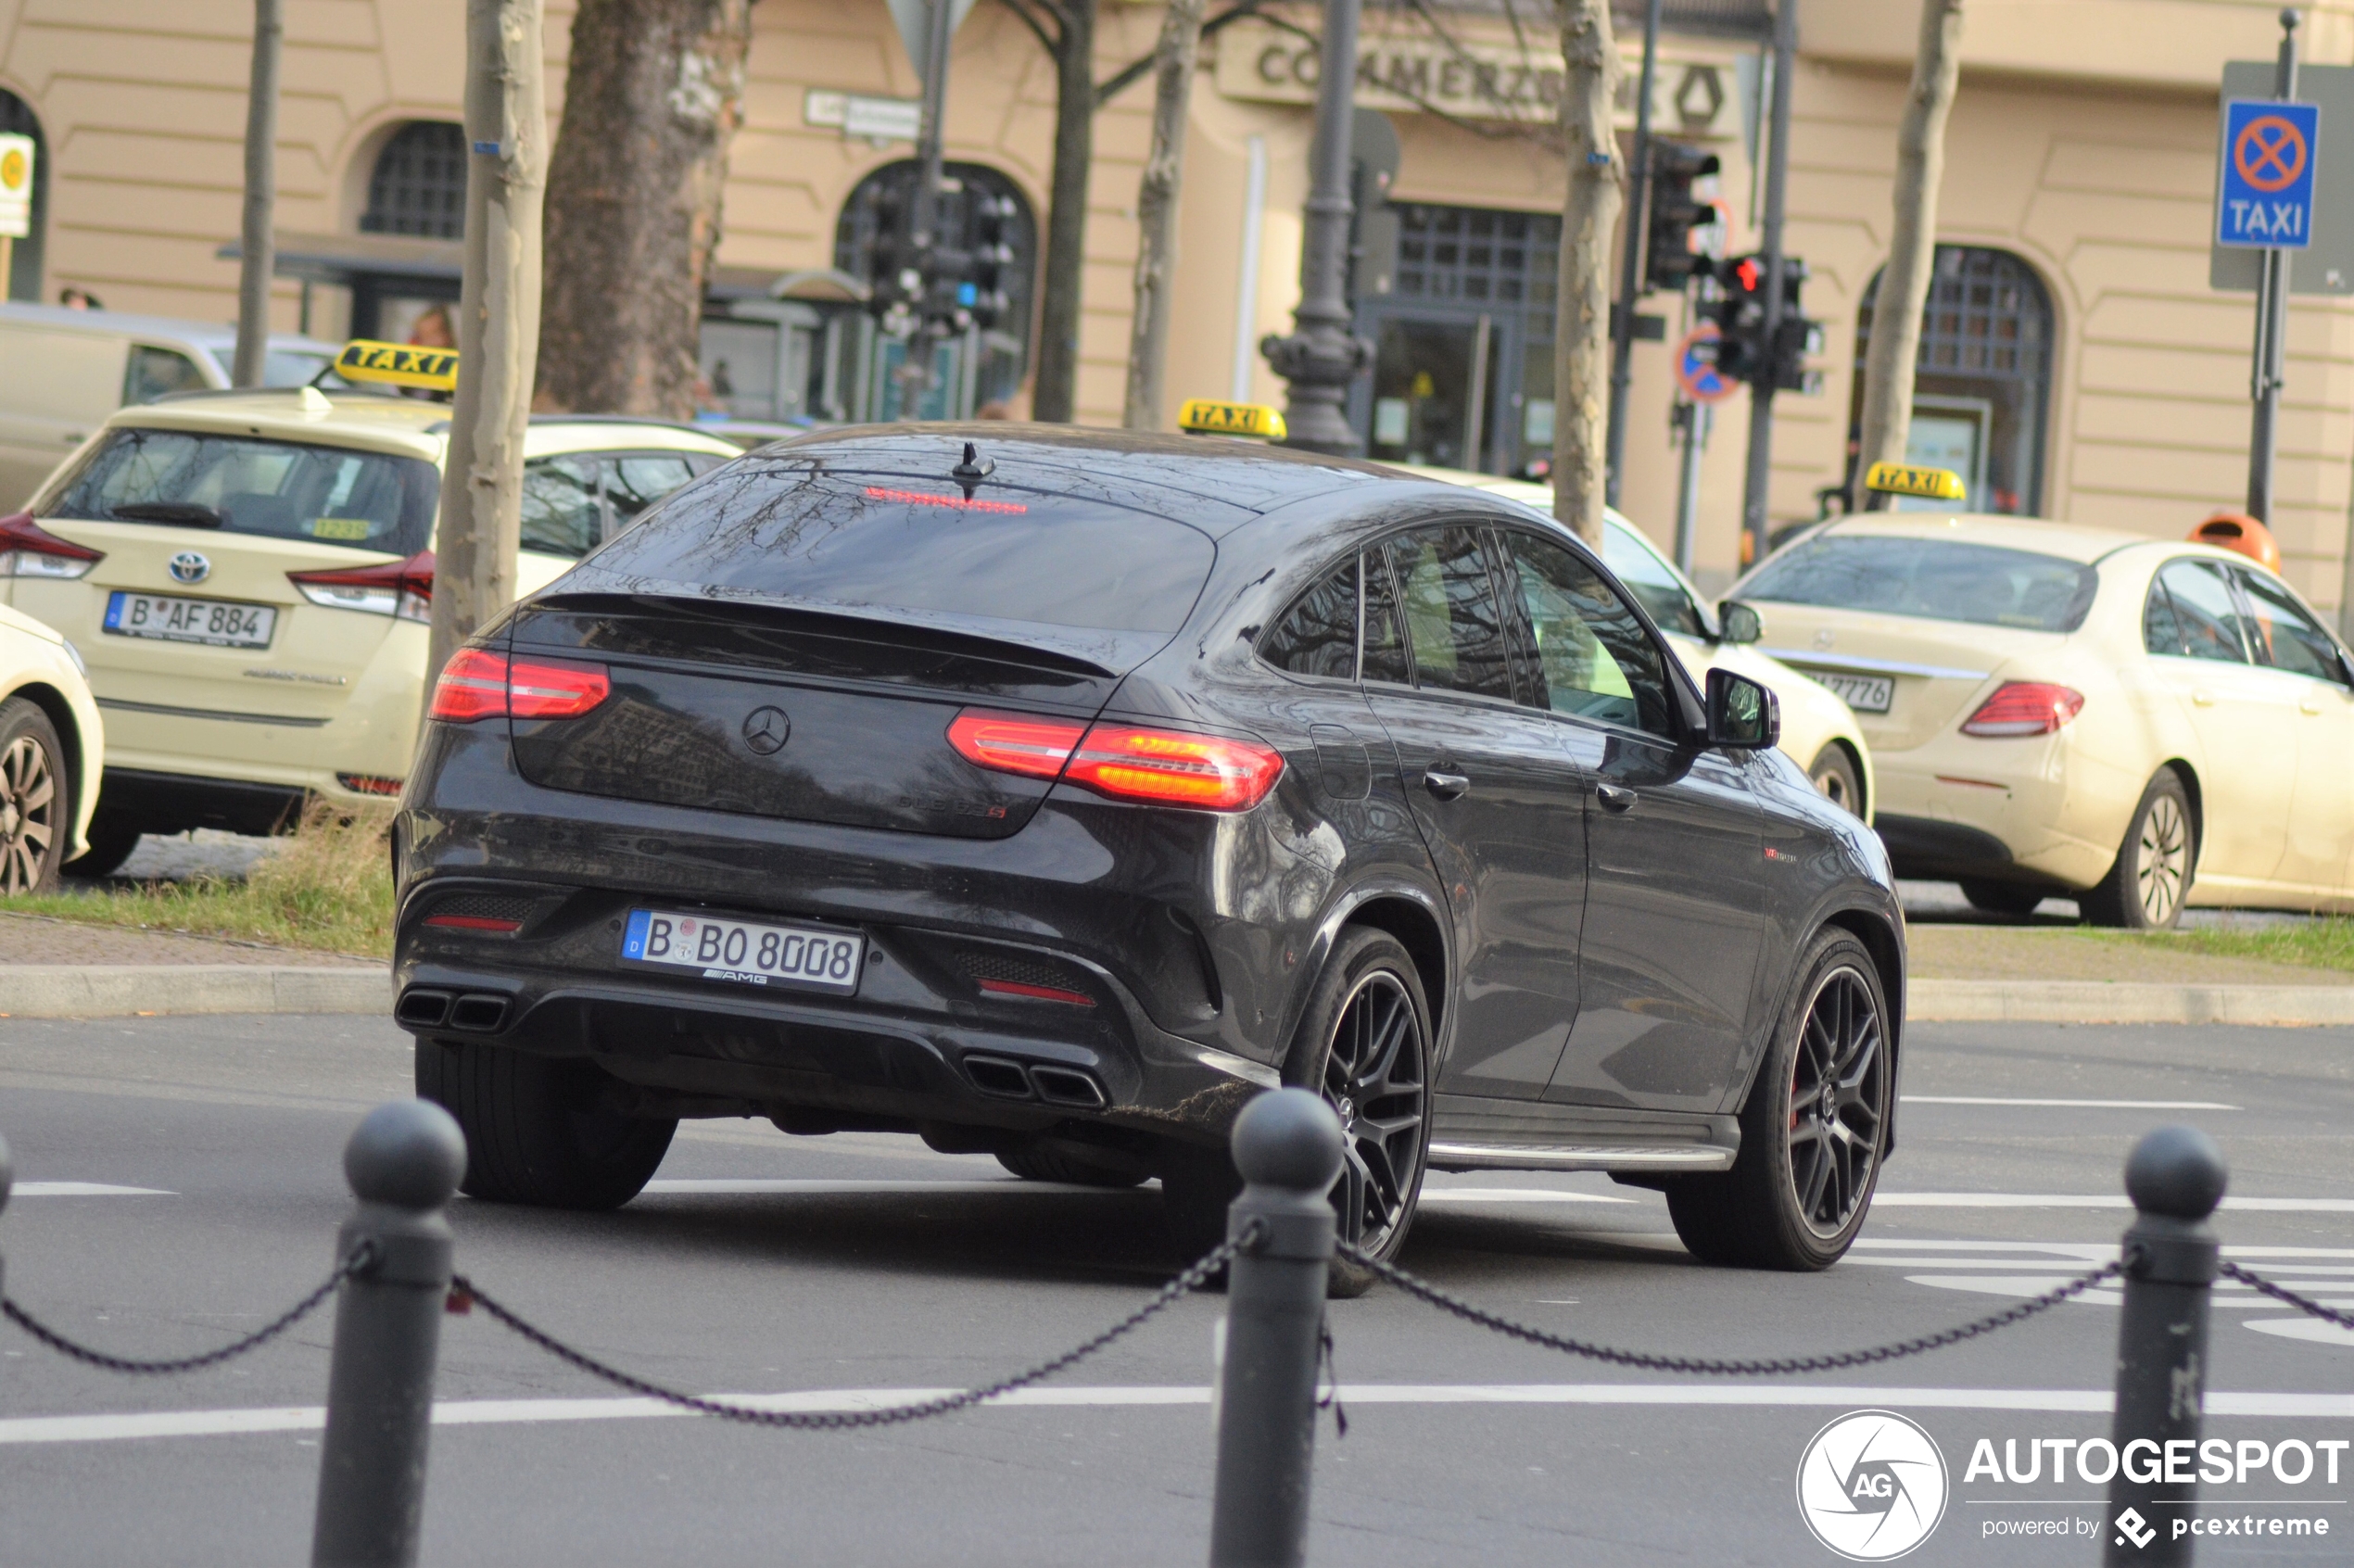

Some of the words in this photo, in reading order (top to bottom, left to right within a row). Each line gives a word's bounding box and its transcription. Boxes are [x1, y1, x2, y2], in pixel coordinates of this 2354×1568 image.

[2228, 198, 2303, 237] TAXI
[358, 347, 445, 374] TAXI
[1195, 406, 1257, 427] TAXI
[1881, 468, 1939, 491] TAXI
[130, 599, 150, 626] B
[167, 602, 206, 631] AF
[208, 606, 261, 638] 884
[647, 918, 674, 957] B
[697, 924, 748, 967] BO
[756, 931, 854, 980] 8008
[720, 970, 768, 985] AMG
